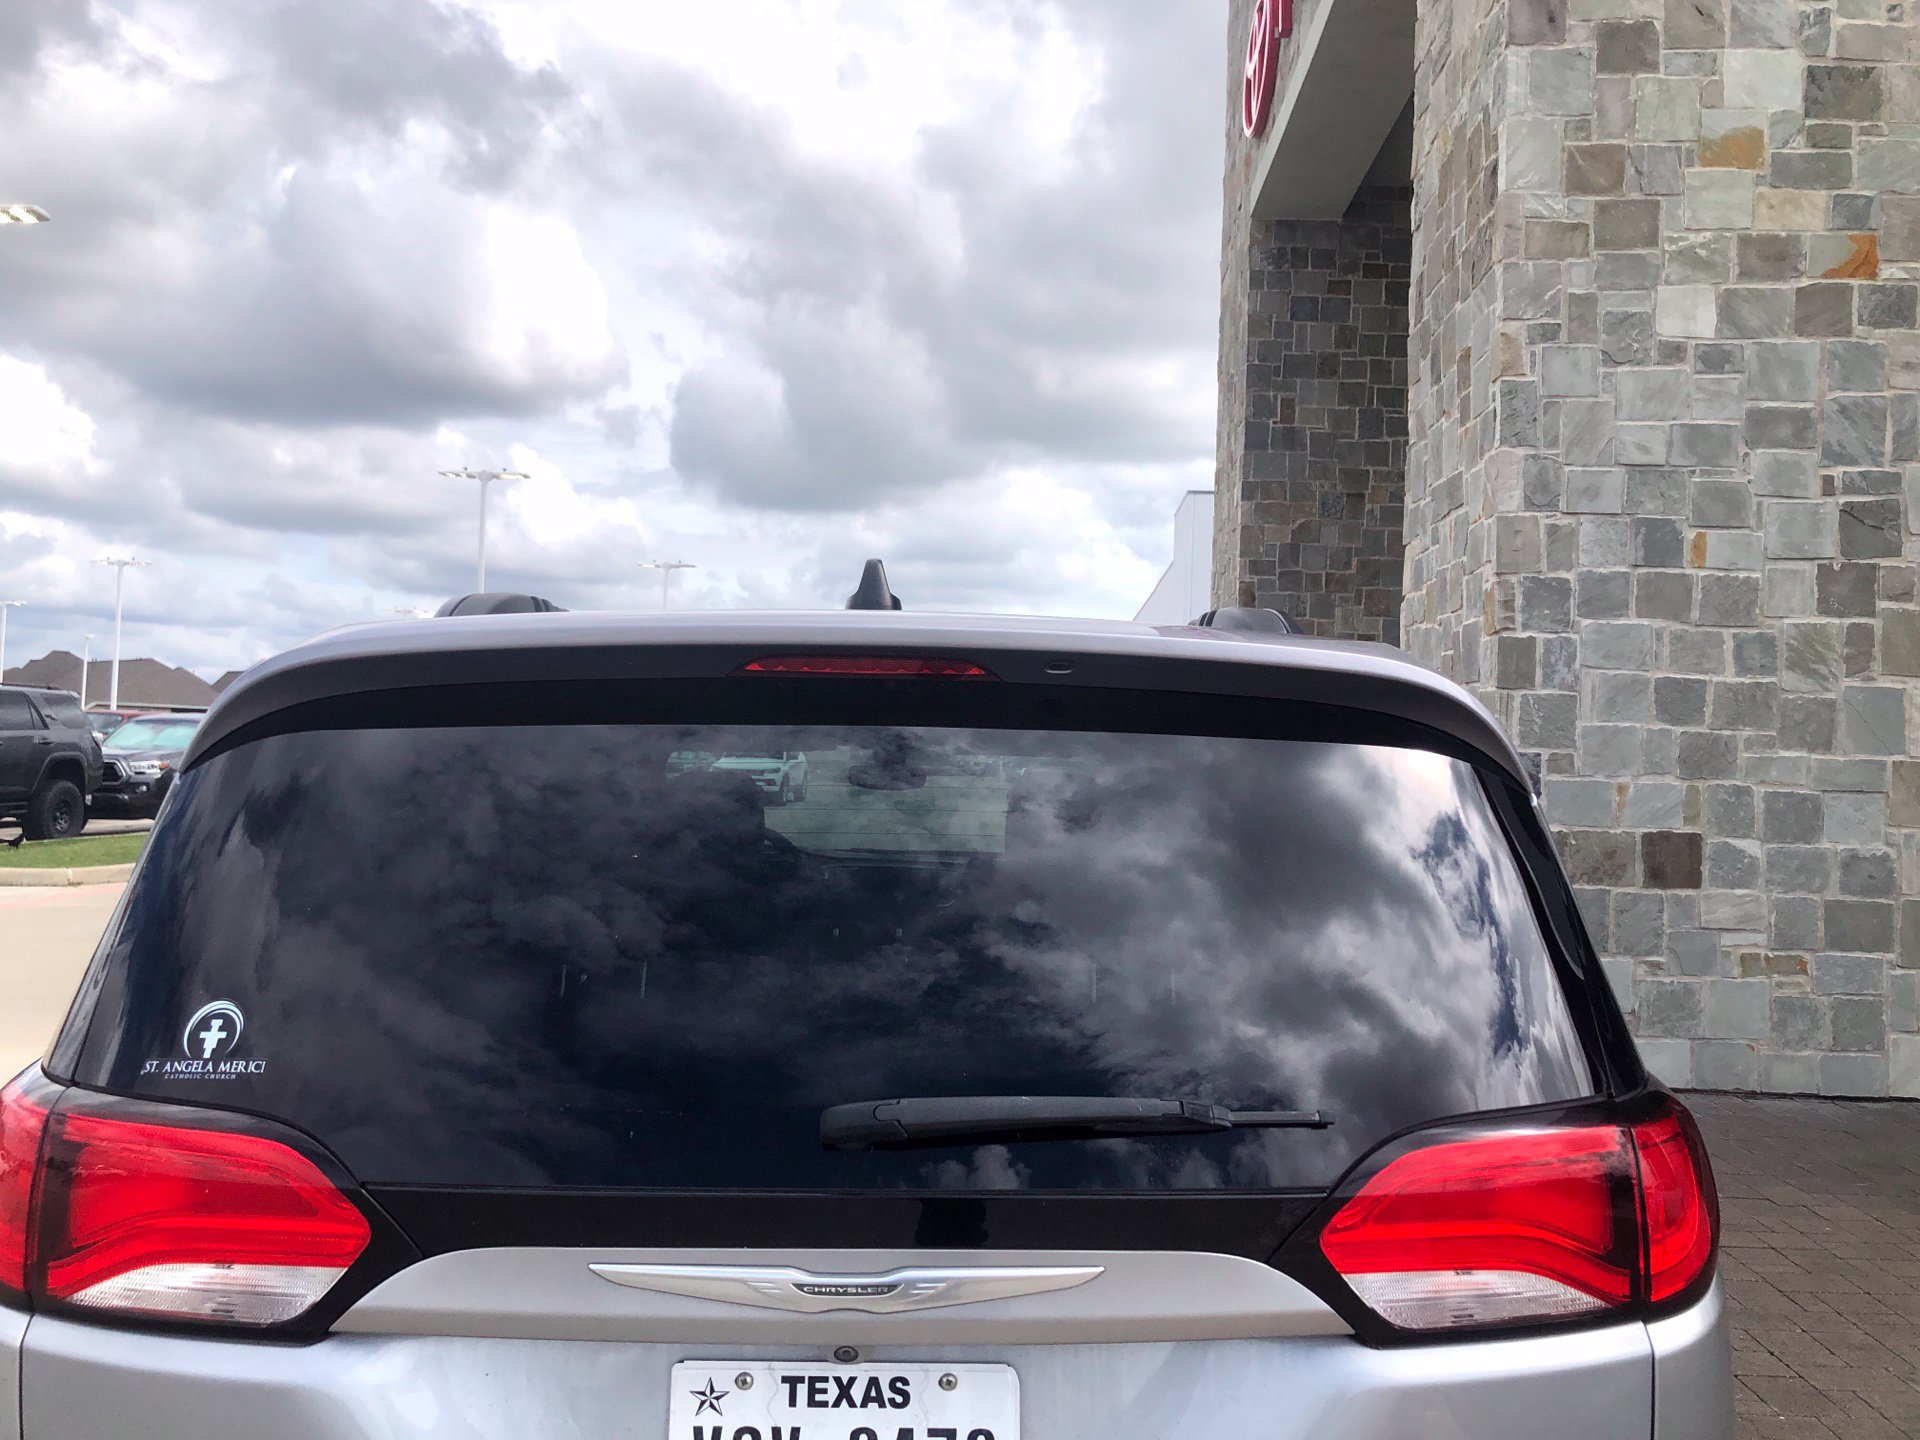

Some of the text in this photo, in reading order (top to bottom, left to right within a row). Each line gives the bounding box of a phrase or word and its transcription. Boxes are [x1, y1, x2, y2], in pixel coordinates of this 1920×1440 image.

[142, 1060, 267, 1073] ST. ANGELA MERICI
[781, 1375, 911, 1409] TEXAS
